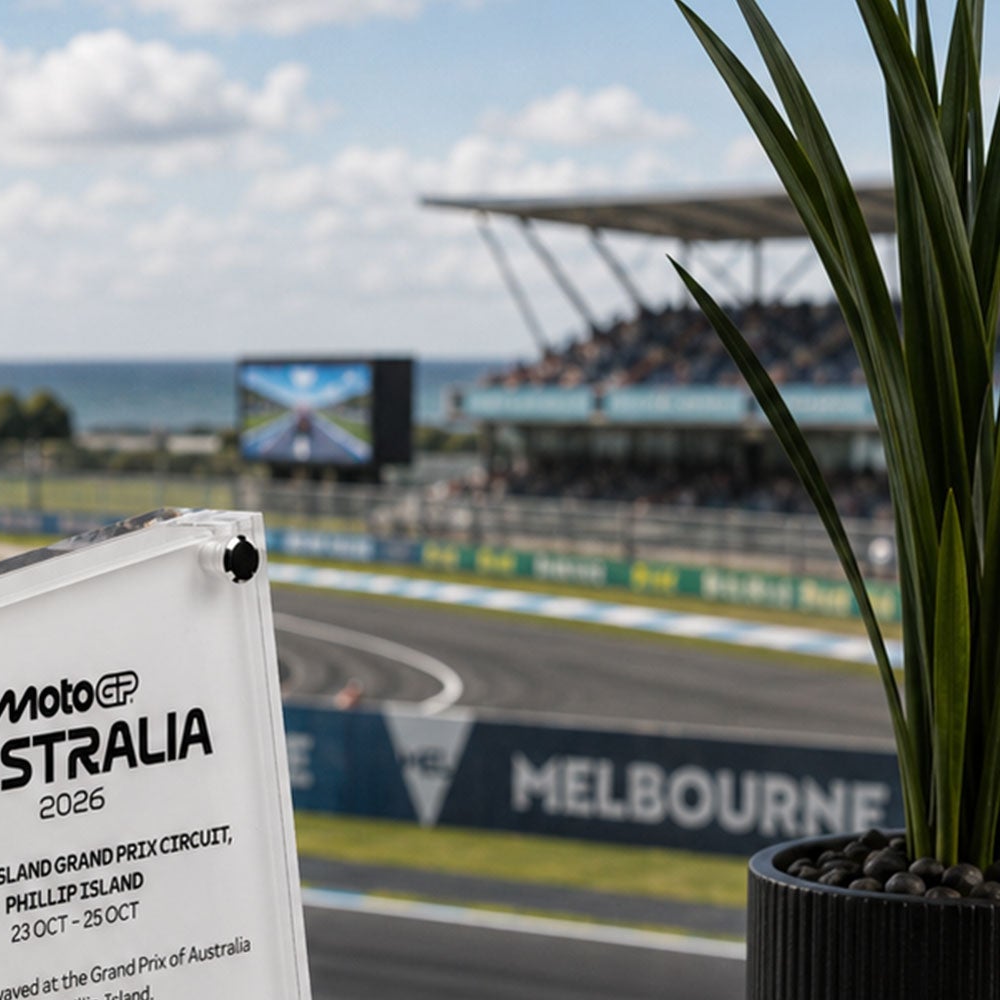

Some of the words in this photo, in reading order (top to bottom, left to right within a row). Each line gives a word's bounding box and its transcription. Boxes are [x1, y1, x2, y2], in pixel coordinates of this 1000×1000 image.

[39, 786, 106, 820] 2026
[510, 751, 891, 836] MELBOURNE
[54, 847, 114, 875] GRAND
[116, 838, 158, 864] PRIX
[159, 825, 233, 855] CIRCUIT,
[5, 883, 78, 915] PHILLIP
[79, 871, 145, 900] ISLAND
[11, 922, 31, 944] 23
[33, 914, 69, 939] OCT
[83, 907, 104, 929] 25
[105, 900, 140, 924] OCT
[42, 976, 60, 994] at
[61, 970, 89, 990] the
[90, 957, 137, 984] Grand
[138, 955, 167, 975] Prix
[169, 946, 187, 968] of
[187, 937, 252, 965] Australia
